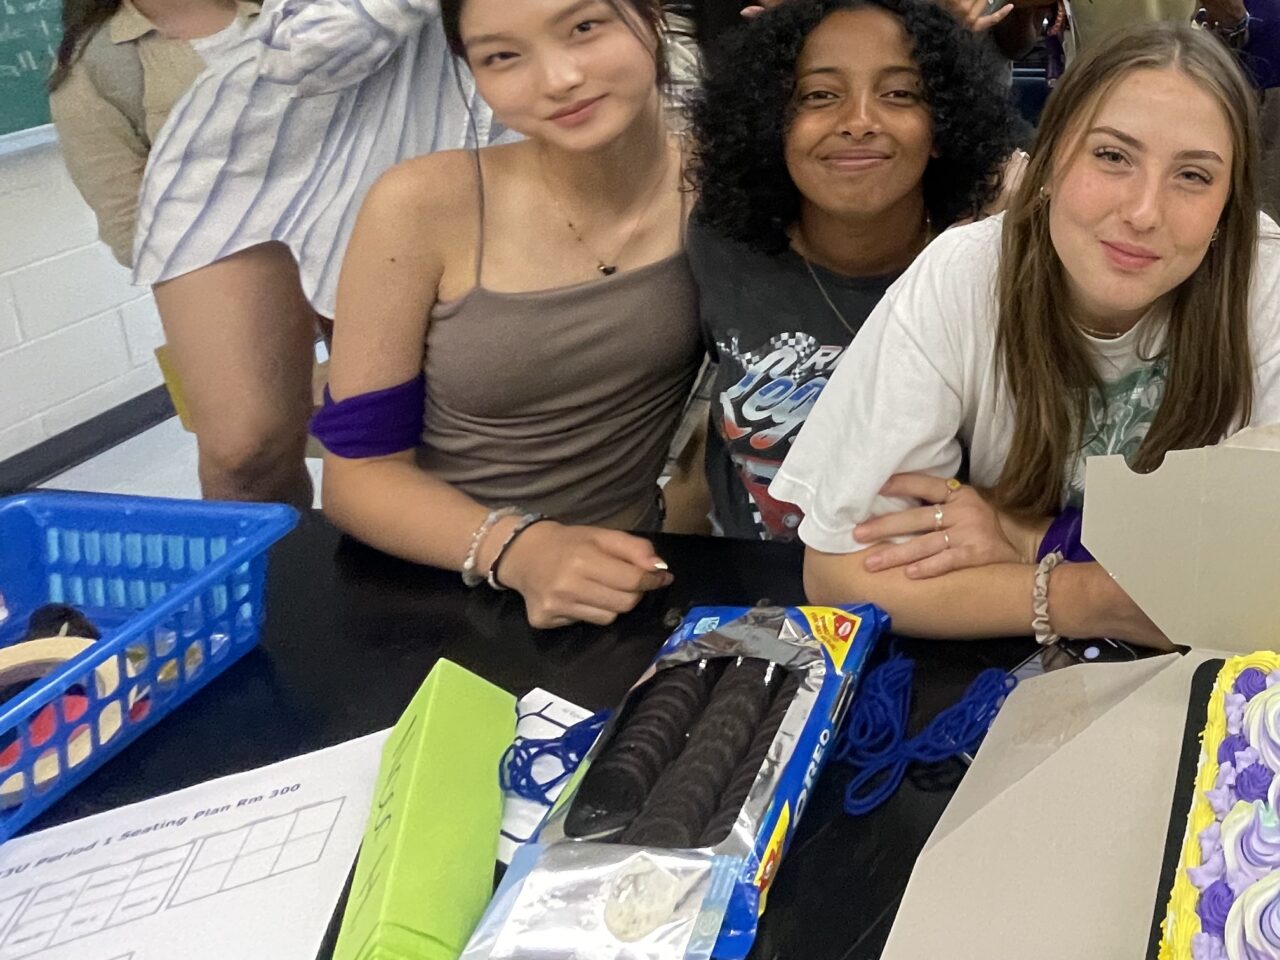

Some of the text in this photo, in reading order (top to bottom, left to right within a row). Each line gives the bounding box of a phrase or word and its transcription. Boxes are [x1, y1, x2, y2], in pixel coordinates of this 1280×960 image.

[33, 840, 99, 868] Period
[118, 816, 188, 841] Seating
[193, 804, 231, 821] Plan
[236, 795, 263, 808] Rm
[268, 783, 301, 799] 300
[792, 728, 831, 830] OREO
